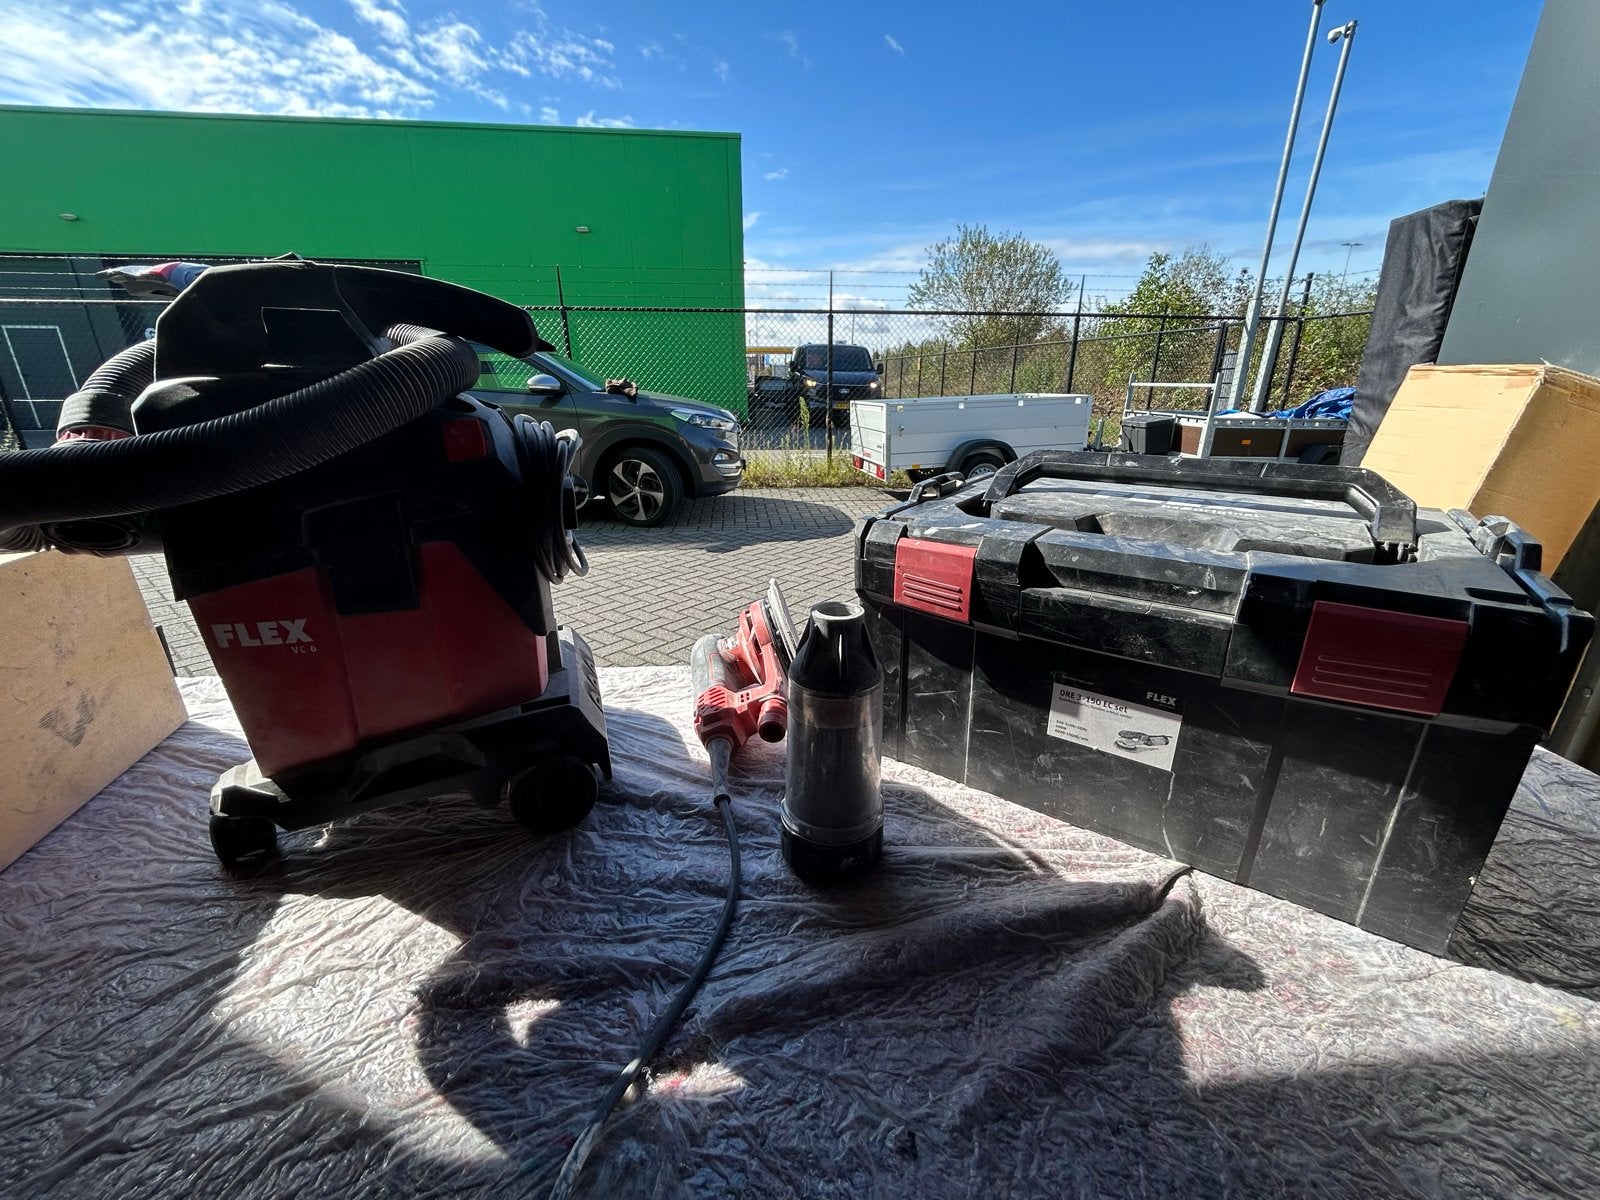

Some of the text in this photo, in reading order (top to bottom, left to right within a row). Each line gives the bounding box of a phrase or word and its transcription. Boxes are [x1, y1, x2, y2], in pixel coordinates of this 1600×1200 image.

[211, 618, 314, 648] FLEX
[291, 645, 317, 654] VC 6
[1059, 688, 1075, 700] ORE
[1076, 693, 1102, 706] 3-150
[1103, 700, 1113, 709] EC
[1114, 704, 1128, 714] set
[1146, 691, 1178, 706] FLEX
